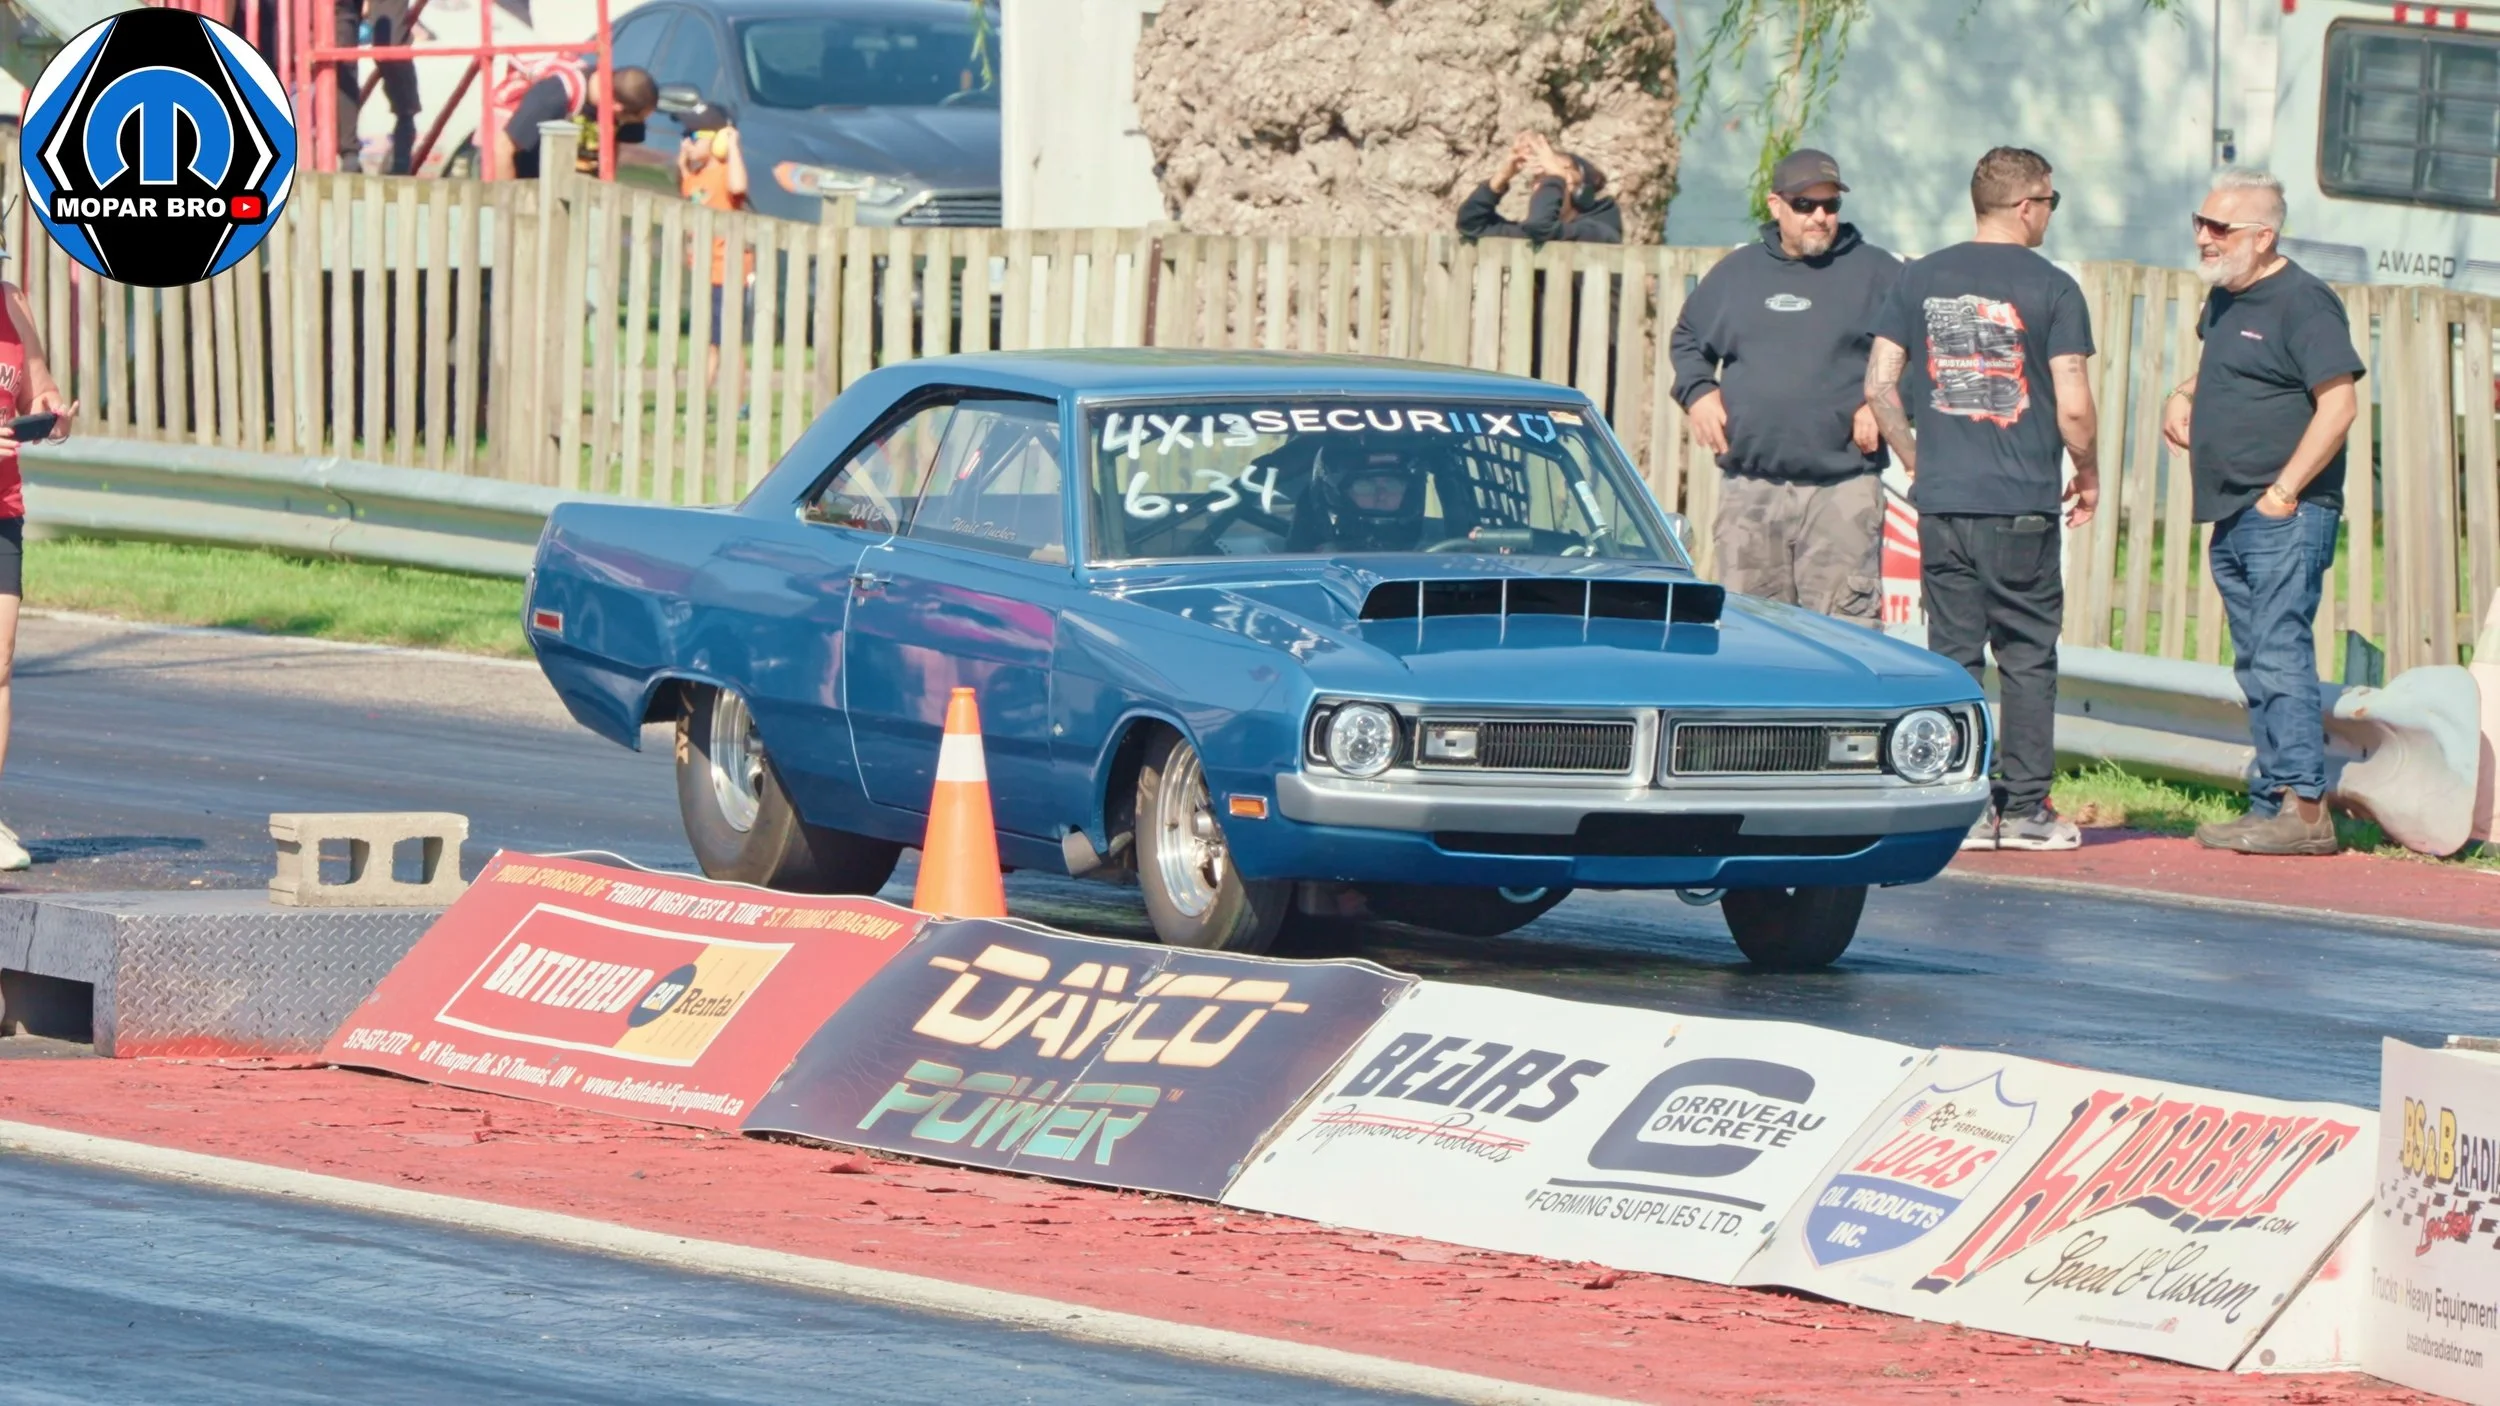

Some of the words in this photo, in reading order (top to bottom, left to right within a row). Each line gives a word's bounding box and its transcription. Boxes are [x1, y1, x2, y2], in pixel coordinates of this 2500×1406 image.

[2378, 250, 2457, 279] AWARD
[1102, 412, 1259, 460] 4X13
[849, 503, 887, 522] 4X13
[1124, 465, 1290, 519] 6.34
[491, 864, 537, 885] PROUD
[528, 867, 592, 894] SPONSOR
[583, 878, 612, 898] OF
[648, 891, 700, 916] NIGHT
[690, 897, 727, 920] TEST
[716, 901, 736, 922] &
[781, 908, 835, 930] THOMAS
[825, 911, 905, 941] DRAGWAY
[482, 942, 655, 1014] BATTLEFIELD
[640, 982, 684, 1011] CAT
[673, 988, 746, 1018] Rental
[912, 943, 1310, 1068] DAYCO
[418, 1040, 439, 1062] 81
[431, 1044, 479, 1074] Harper
[548, 1065, 578, 1089] ON
[581, 1075, 745, 1117] www.BattlefieldEquipment.ca
[1336, 1032, 1611, 1123] BEARS
[856, 1059, 1162, 1166] POWER
[1297, 1103, 1420, 1156] Performance
[1417, 1112, 1525, 1163] Products
[1952, 1121, 2015, 1144] PERFORMANCE
[1852, 1129, 1998, 1189] LUCAS
[2459, 1133, 2500, 1195] RADI
[1528, 1190, 1613, 1218] FORMING
[1609, 1197, 1700, 1229] SUPPLIES
[1698, 1209, 1744, 1238] LTD.
[1818, 1186, 1850, 1208] OIL
[1843, 1188, 1946, 1229] PRODUCTS
[1911, 1089, 2361, 1294] KARBELT
[1825, 1220, 1869, 1248] INC.
[2257, 1216, 2299, 1235] .COM
[2023, 1230, 2149, 1307] Speed
[2145, 1241, 2261, 1325] Custom
[2371, 1266, 2398, 1305] Trucks
[2405, 1278, 2433, 1323] Heavy
[2435, 1287, 2498, 1331] Equipment
[2406, 1327, 2484, 1369] bsandbradiator.com
